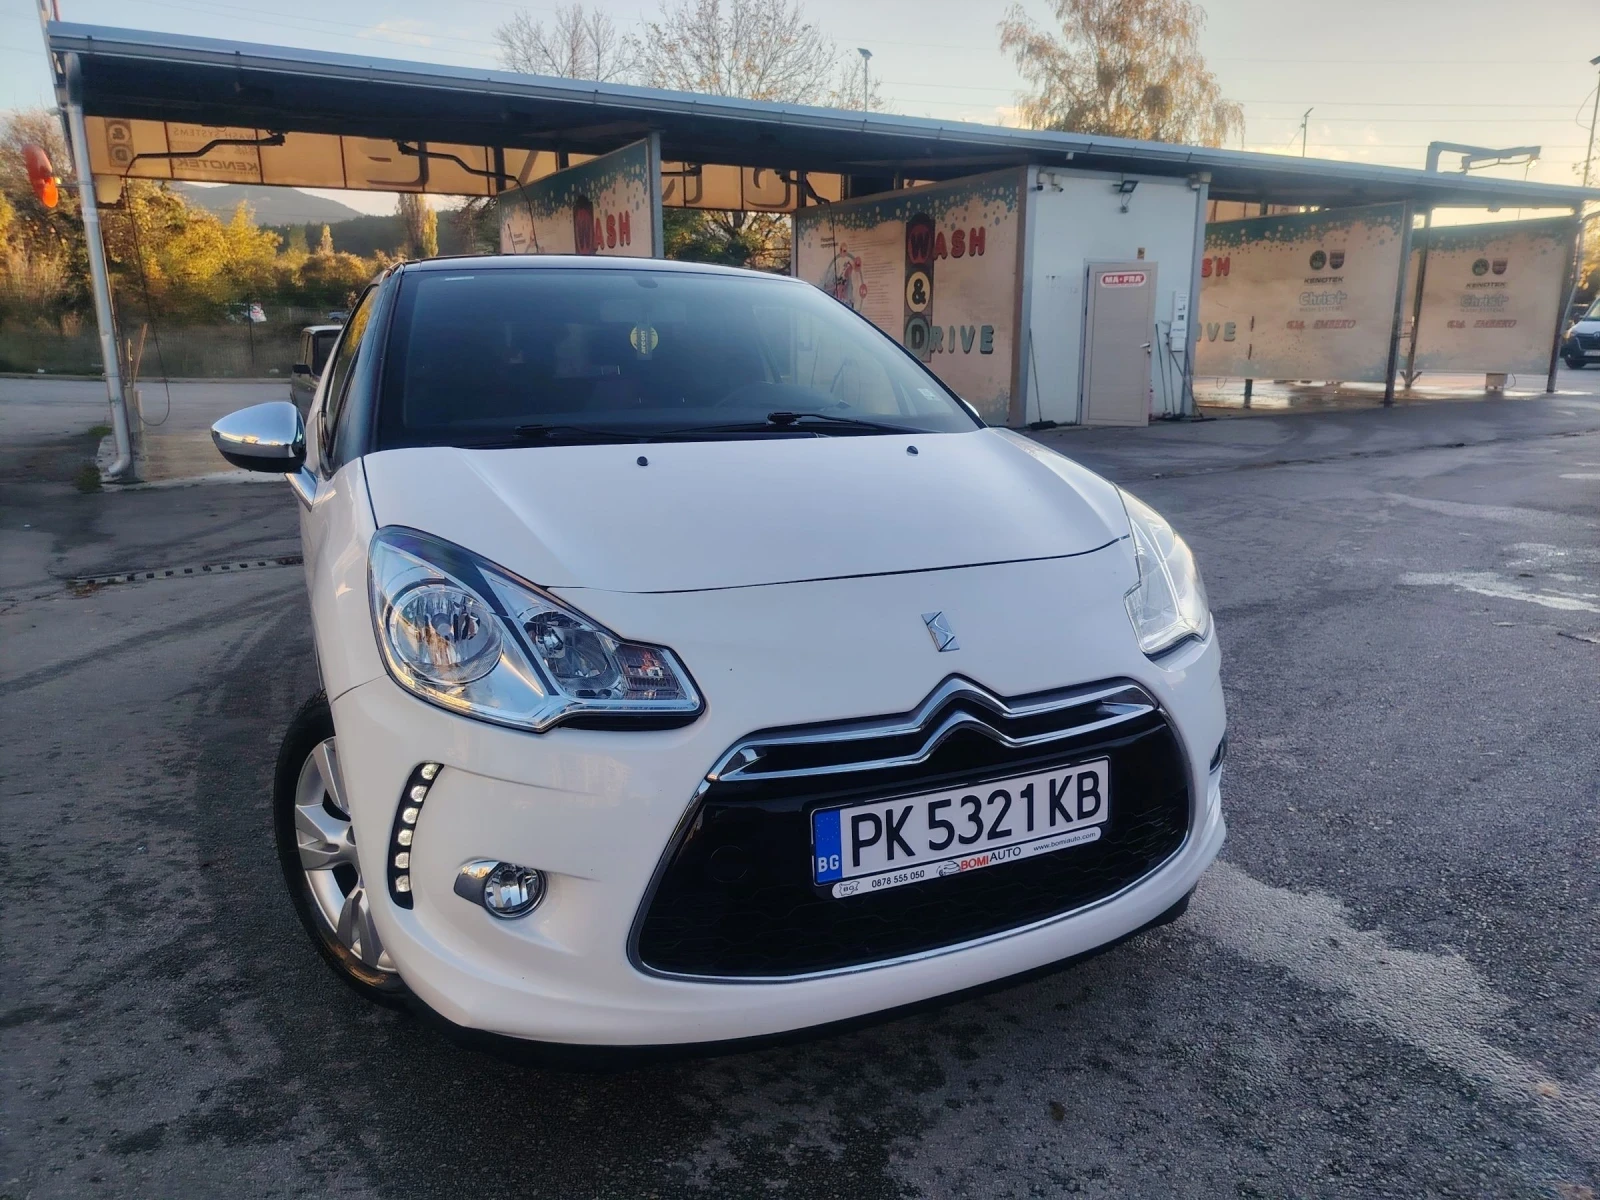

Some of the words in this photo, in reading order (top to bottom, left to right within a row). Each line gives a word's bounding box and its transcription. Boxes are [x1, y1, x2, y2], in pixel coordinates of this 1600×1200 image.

[906, 223, 987, 264] WASH
[911, 278, 927, 305] &
[1304, 276, 1345, 284] KENOTEK
[1299, 290, 1348, 306] Christ
[907, 320, 995, 355] DRIVE
[851, 804, 916, 868] PK
[927, 782, 1034, 851] 5321
[1049, 770, 1101, 828] KB
[817, 853, 840, 873] BG
[843, 885, 855, 893] BG
[871, 877, 892, 888] 0878
[893, 874, 908, 884] 555
[910, 870, 925, 881] 050
[1033, 831, 1096, 852] www.bomiauto.com
